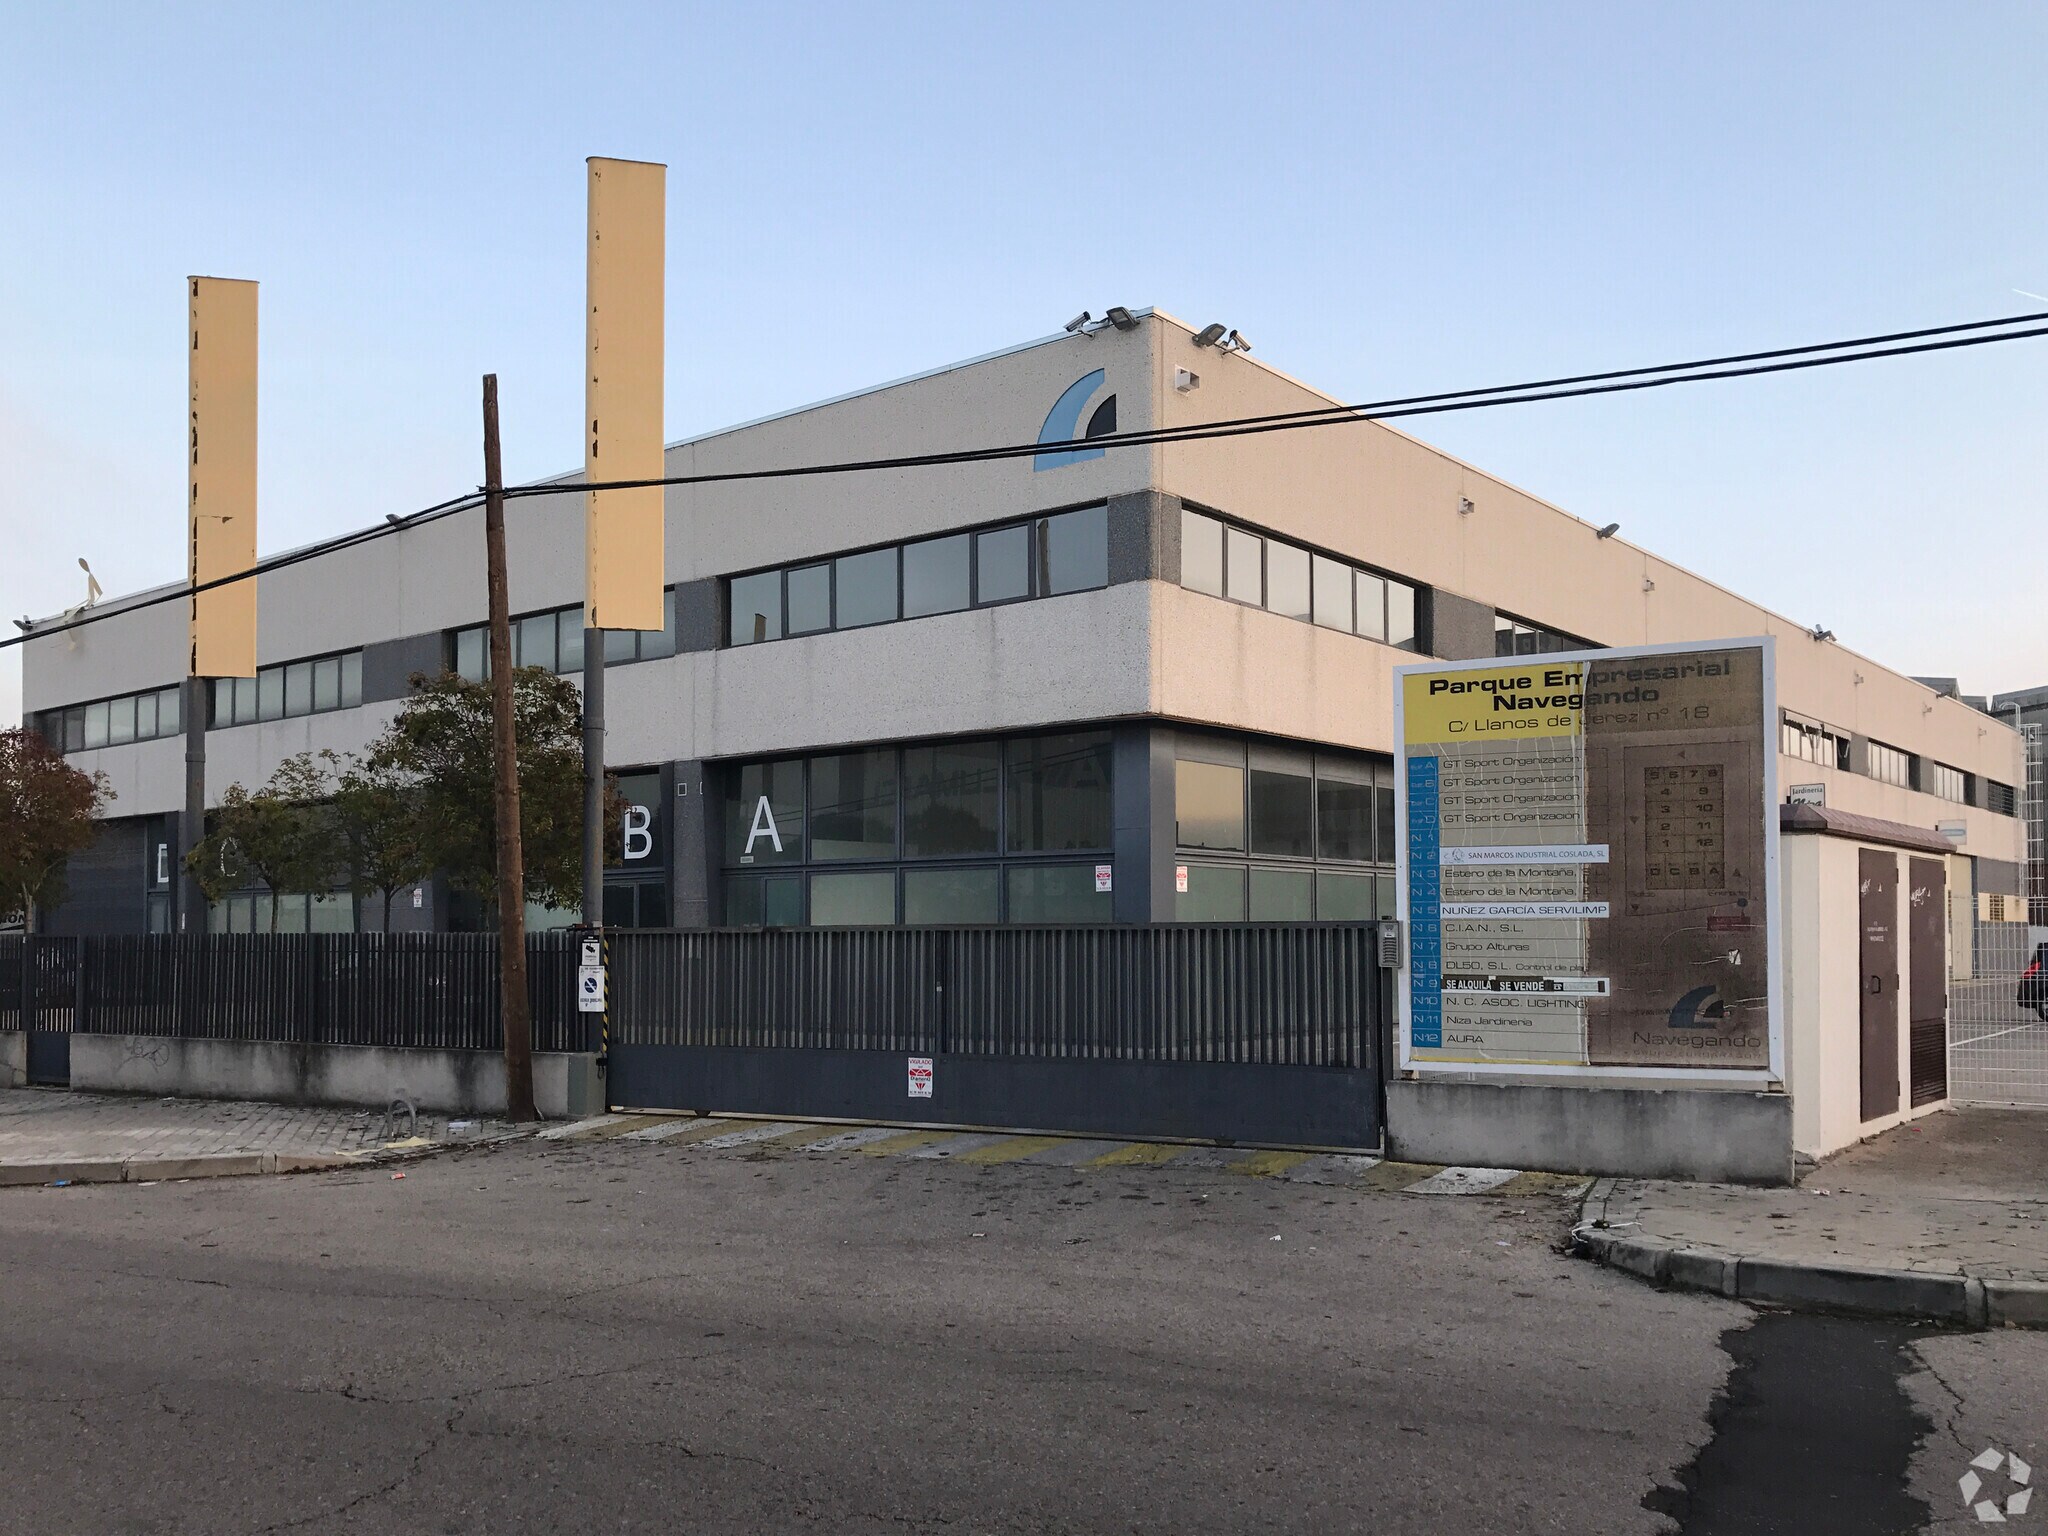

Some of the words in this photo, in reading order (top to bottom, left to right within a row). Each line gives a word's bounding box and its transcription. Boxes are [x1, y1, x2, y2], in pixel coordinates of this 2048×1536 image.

[1429, 676, 1532, 695] Parque
[1544, 659, 1730, 687] Empresarial
[1493, 687, 1660, 712] Navegando
[1448, 720, 1468, 733] C/
[1474, 718, 1539, 731] Llanos
[1546, 714, 1571, 728] de
[1679, 705, 1710, 721] 18
[1443, 760, 1461, 768] GT
[1464, 758, 1500, 769] Sport
[1502, 755, 1580, 766] Organización
[1689, 770, 1698, 778] 7
[1443, 778, 1461, 787] GT
[1464, 777, 1500, 787] Sport
[1502, 774, 1580, 785] Organización
[1661, 787, 1671, 796] 4
[1699, 787, 1709, 795] 9
[1443, 796, 1461, 805] GT
[1465, 795, 1500, 805] Sport
[1503, 793, 1580, 804] Organización
[1661, 805, 1671, 813] 3
[1696, 803, 1714, 812] 10
[1444, 814, 1461, 823] GT
[1465, 813, 1500, 823] Sport
[1503, 812, 1580, 822] Organización
[744, 795, 784, 854] A
[1661, 822, 1671, 831] 2
[1697, 821, 1711, 829] 11
[624, 805, 653, 859] B
[1662, 839, 1670, 847] 1
[1696, 838, 1714, 847] 12
[1515, 851, 1557, 859] INDUSTRIAL
[1559, 850, 1595, 858] COSLADA,
[1445, 869, 1485, 878] Estero
[1487, 869, 1503, 877] de
[1506, 868, 1516, 877] la
[1519, 868, 1577, 878] Montaña,
[1445, 888, 1485, 896] Estero
[1487, 887, 1503, 896] de
[1506, 887, 1516, 896] la
[1519, 887, 1577, 897] Montaña,
[1442, 905, 1486, 915] NUÑEZ
[1488, 904, 1535, 915] GARCÍA
[1539, 905, 1607, 915] SERVILIMP
[1445, 924, 1496, 933] C.I.A.N.,
[1500, 923, 1524, 932] S.L.
[1446, 942, 1483, 951] Grupo
[1486, 942, 1530, 950] Alturas
[1487, 961, 1511, 970] S.L.
[1516, 963, 1552, 971] Control
[1446, 979, 1456, 989] SE
[1458, 979, 1492, 990] ALQUILA
[1500, 981, 1509, 991] SE
[1513, 981, 1545, 991] VENDE
[1446, 997, 1460, 1006] N.
[1464, 997, 1477, 1006] C.
[1481, 998, 1523, 1007] ASOC.
[1527, 999, 1587, 1009] LIGHTING
[1446, 1015, 1472, 1025] Niza
[1446, 1034, 1484, 1044] AURA
[1633, 1031, 1761, 1049] Navegando
